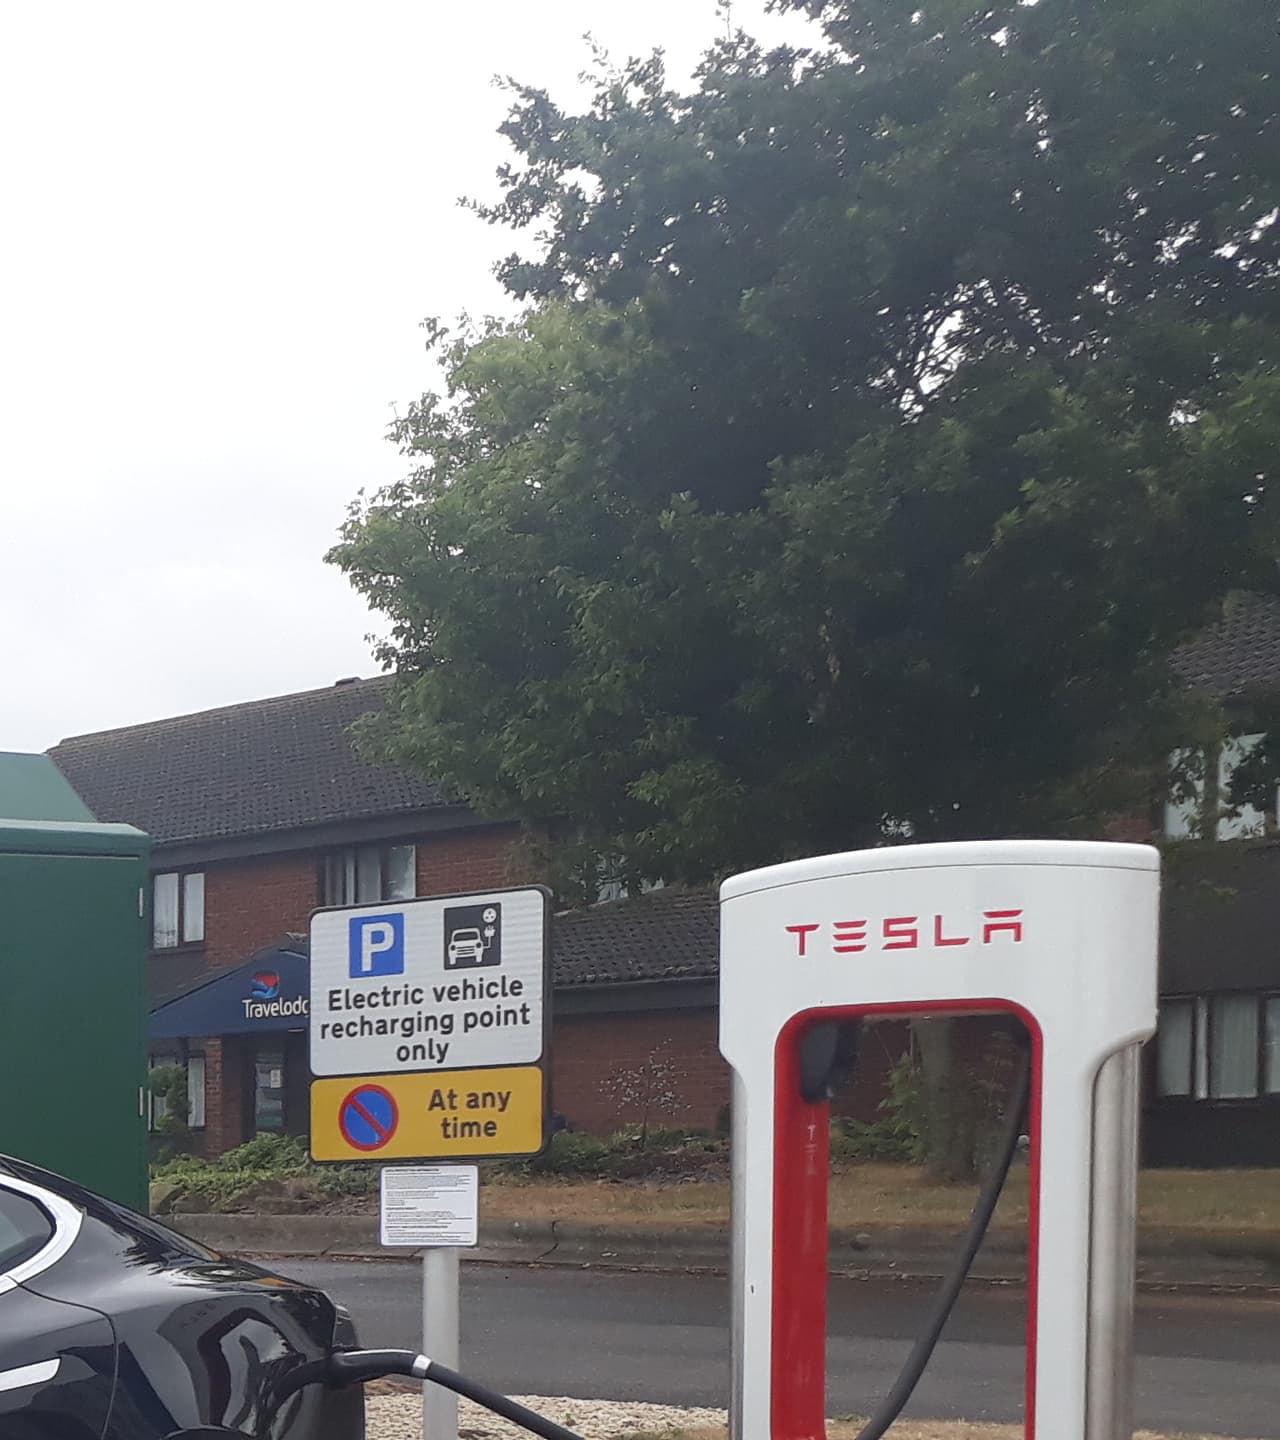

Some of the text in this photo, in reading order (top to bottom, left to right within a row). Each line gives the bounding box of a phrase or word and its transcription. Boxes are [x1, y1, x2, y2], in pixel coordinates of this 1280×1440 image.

[360, 921, 395, 972] P
[784, 909, 1024, 957] TESLA
[328, 975, 524, 1012] Electric vehicle
[320, 1002, 531, 1039] recharging point
[396, 1038, 451, 1064] only
[427, 1089, 512, 1113] At any
[440, 1117, 498, 1139] time
